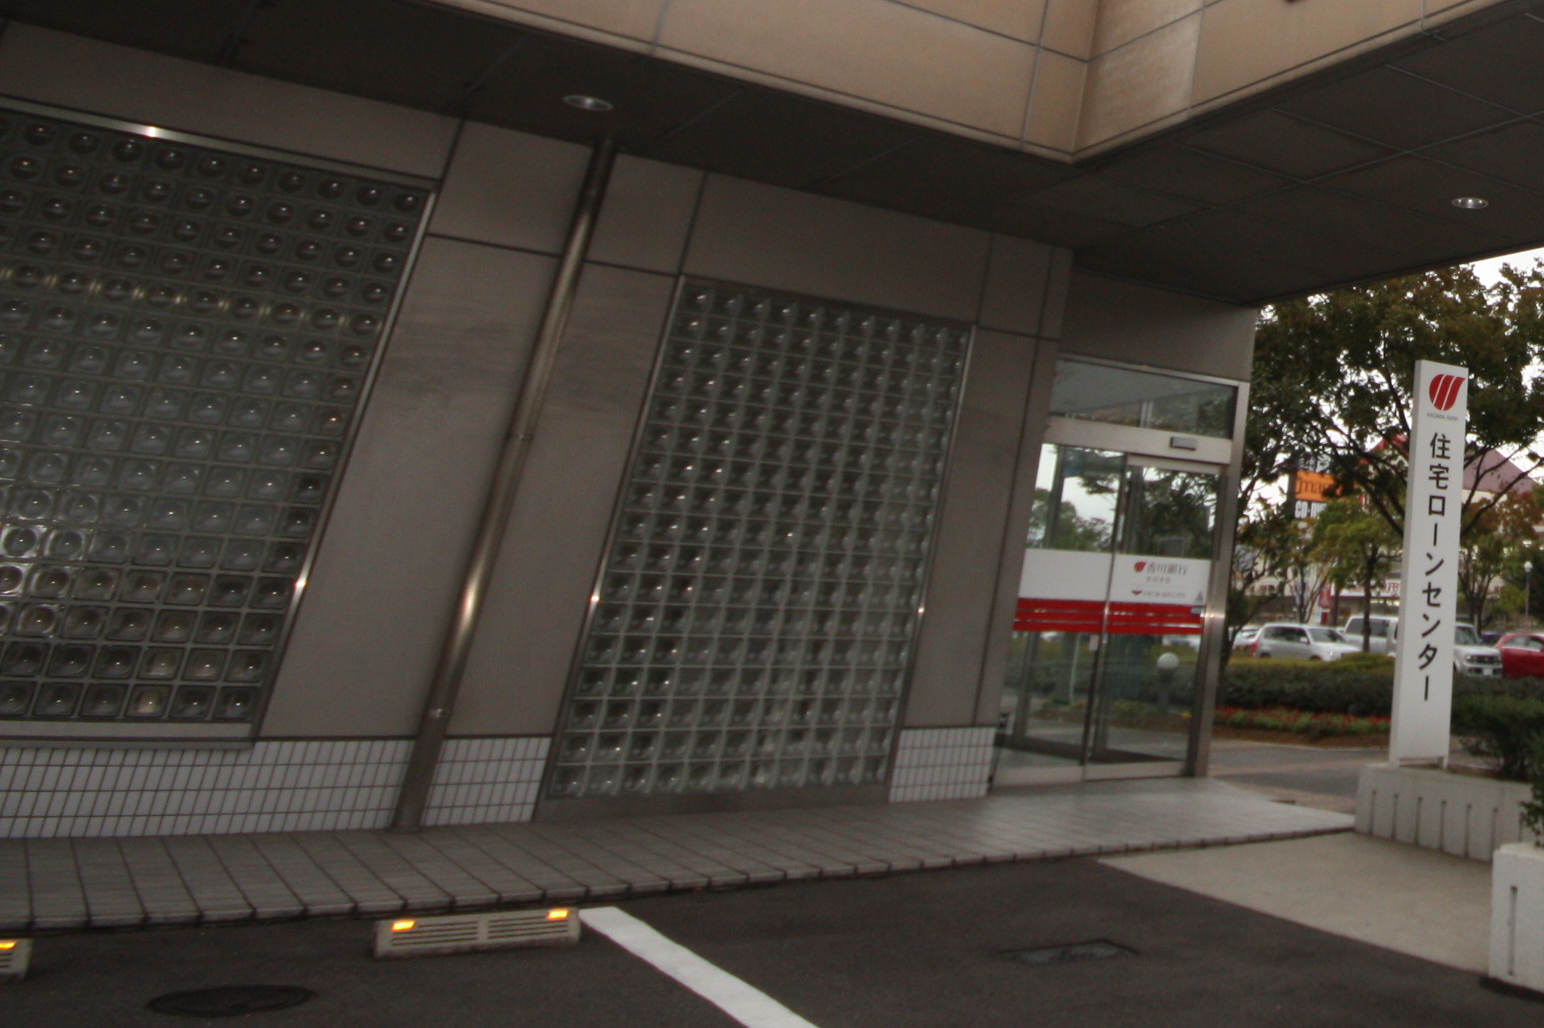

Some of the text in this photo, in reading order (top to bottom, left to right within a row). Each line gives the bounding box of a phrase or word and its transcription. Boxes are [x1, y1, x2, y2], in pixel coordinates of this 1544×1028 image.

[1417, 431, 1452, 702] 住宅ローンセンター
